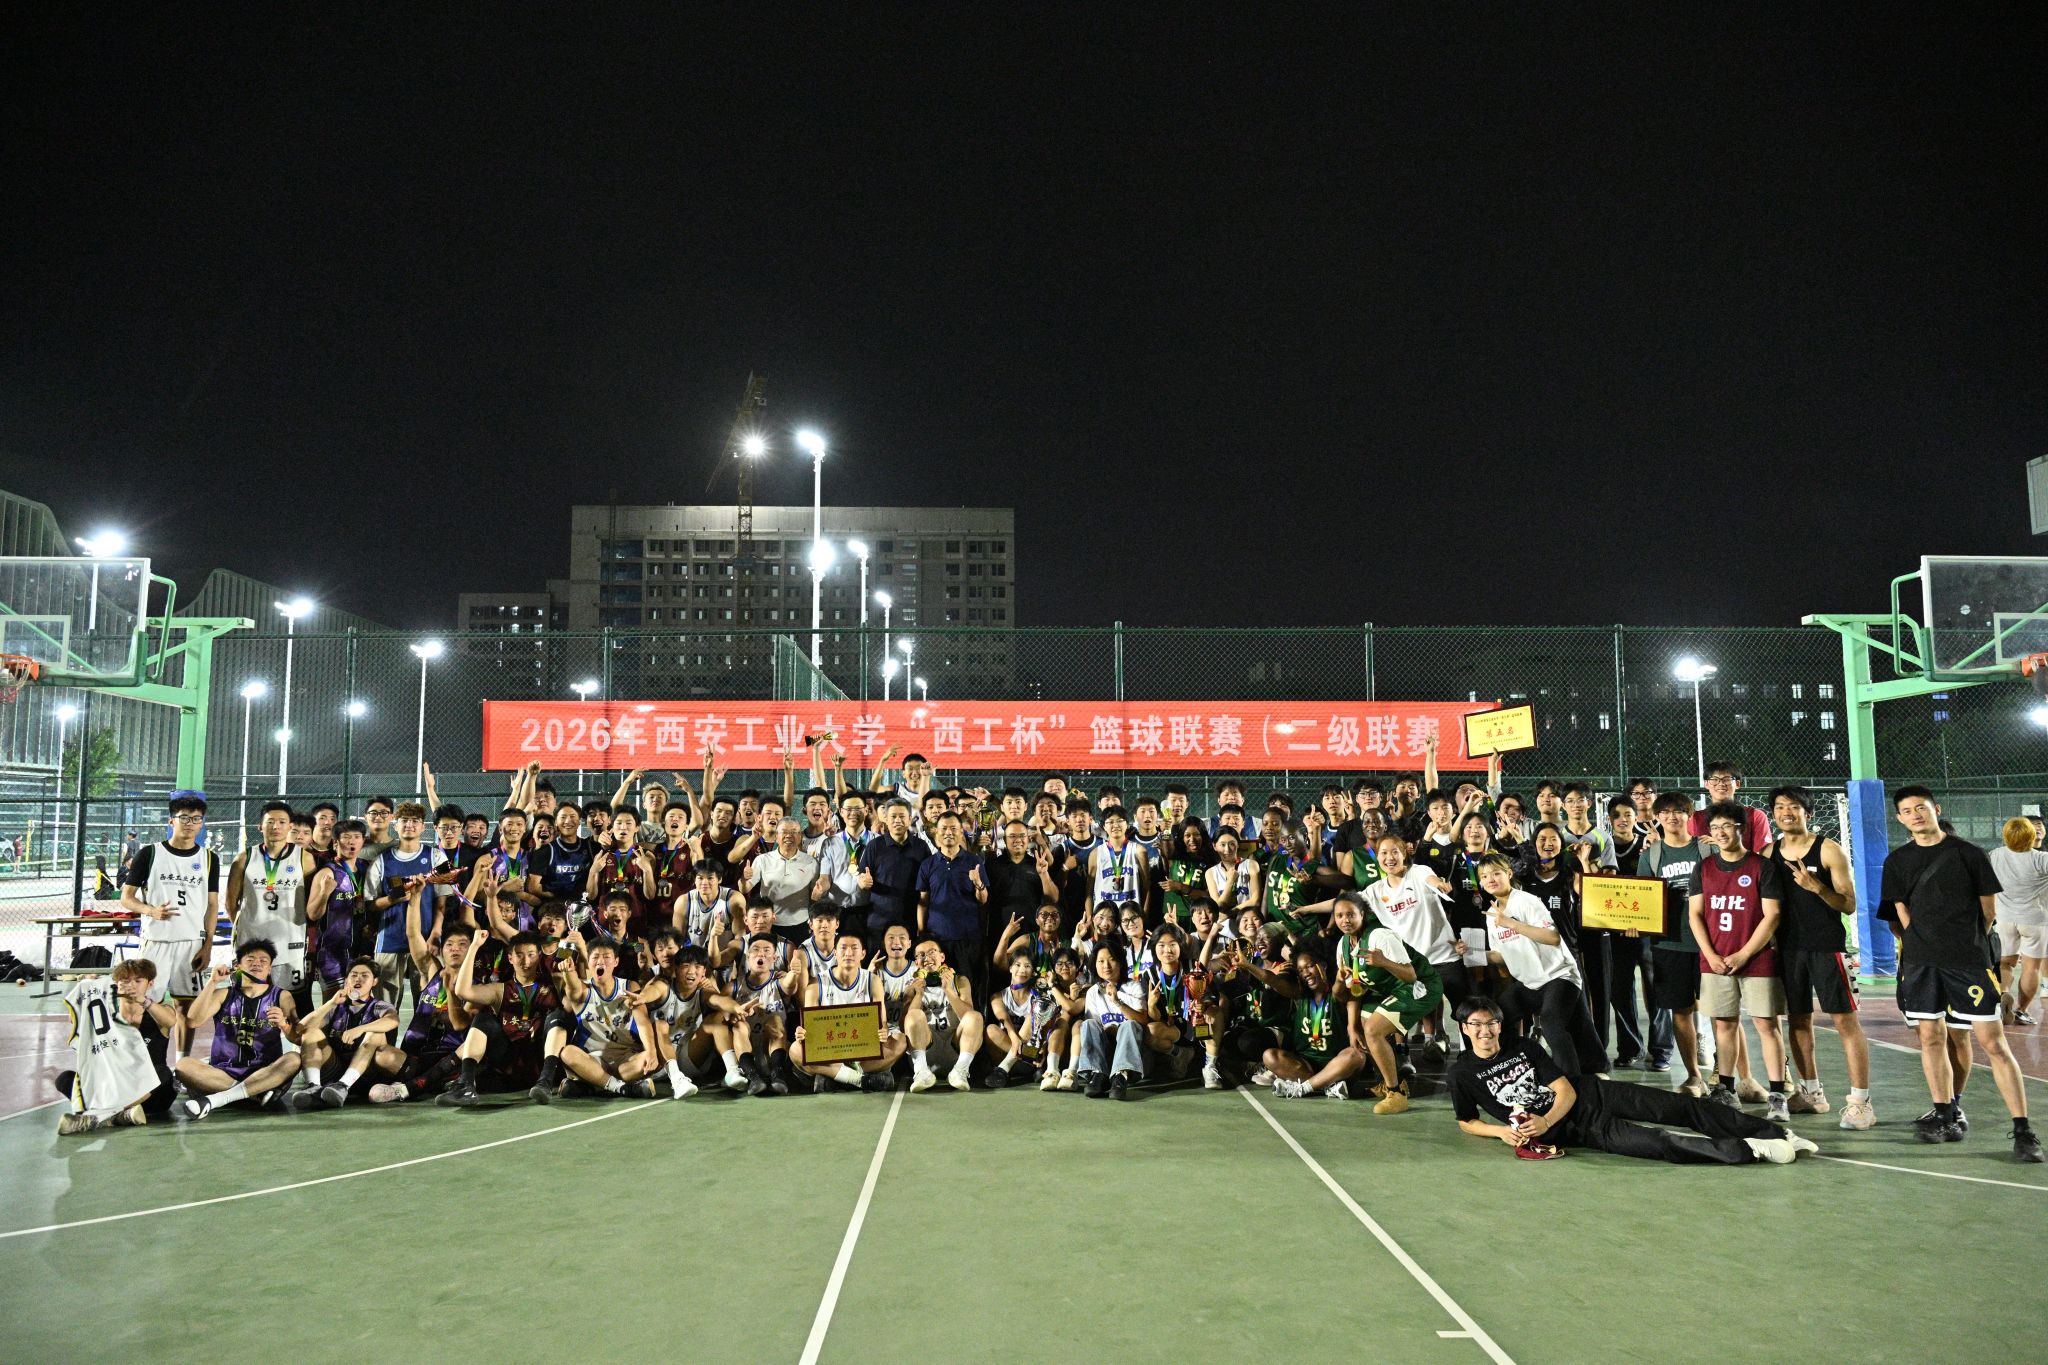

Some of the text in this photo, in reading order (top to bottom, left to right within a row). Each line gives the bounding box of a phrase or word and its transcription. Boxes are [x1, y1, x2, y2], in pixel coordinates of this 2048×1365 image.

[177, 890, 187, 906] 5
[1604, 898, 1640, 912] 第八名
[1718, 912, 1734, 932] 9
[1967, 984, 1985, 1008] 9
[87, 998, 111, 1036] 0
[1301, 1016, 1333, 1036] SE
[236, 1029, 255, 1047] 25
[826, 1028, 859, 1043] 第四名
